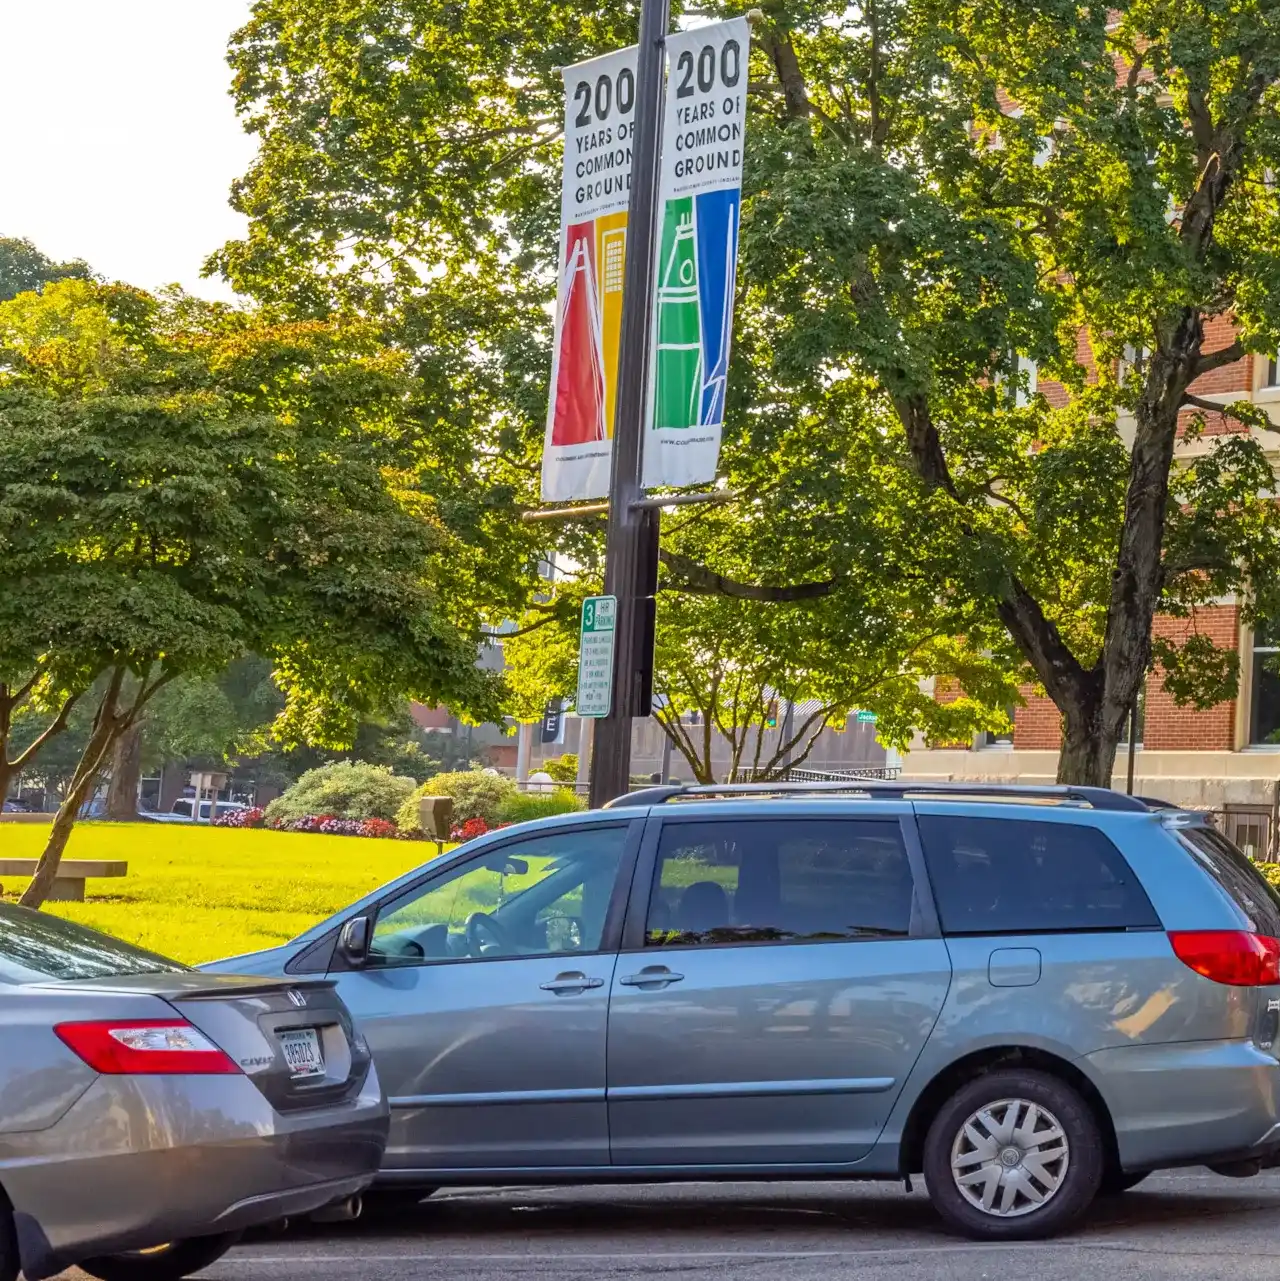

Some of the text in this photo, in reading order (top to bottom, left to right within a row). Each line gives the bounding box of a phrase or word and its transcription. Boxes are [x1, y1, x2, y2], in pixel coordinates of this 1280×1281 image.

[677, 39, 740, 99] 200
[574, 67, 634, 128] 200
[677, 96, 740, 126] YEARS OF
[576, 120, 634, 154] YEARS OF
[676, 121, 741, 152] COMMON
[576, 147, 632, 179] COMMON
[675, 149, 740, 178] GROUND
[586, 604, 594, 626] 3
